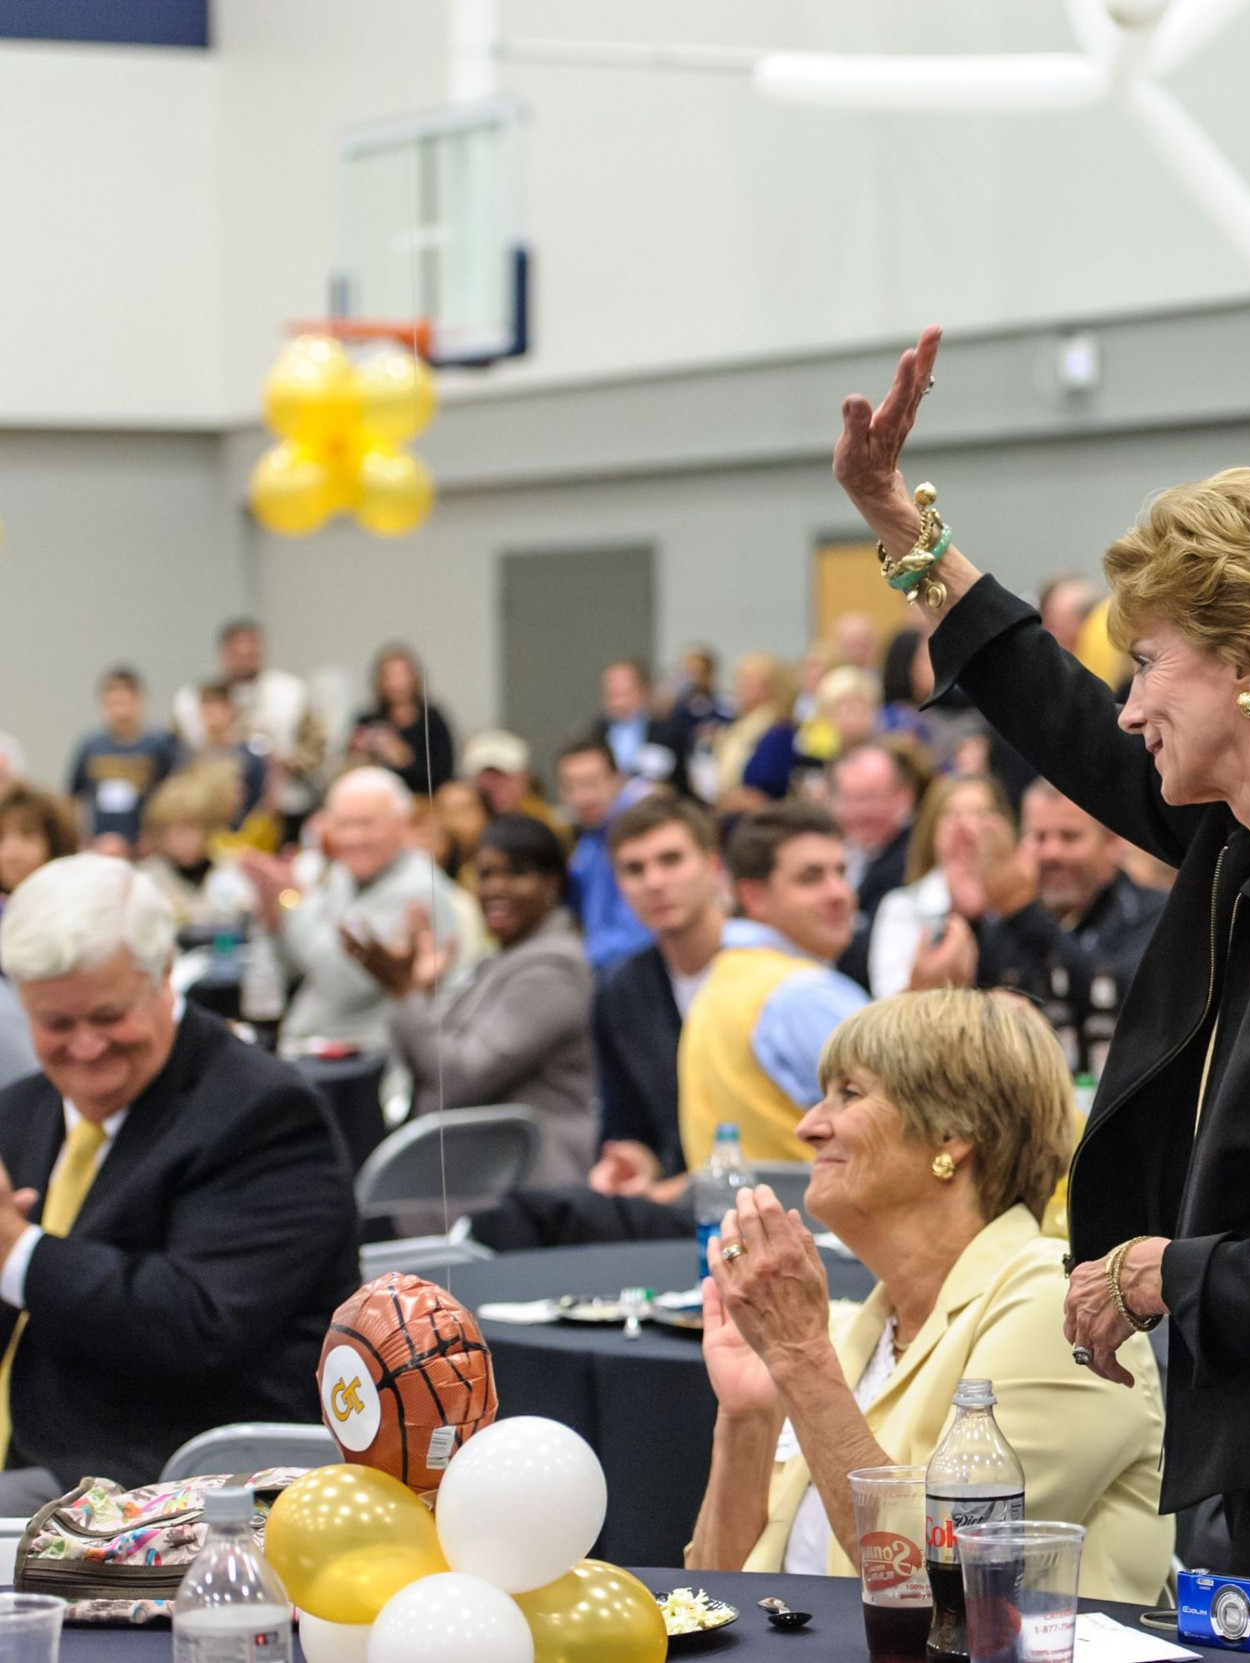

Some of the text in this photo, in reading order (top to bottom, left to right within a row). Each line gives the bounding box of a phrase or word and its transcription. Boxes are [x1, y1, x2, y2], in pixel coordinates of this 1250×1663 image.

[331, 1376, 366, 1422] GT
[925, 1516, 961, 1548] Cok
[952, 1513, 984, 1528] Diet
